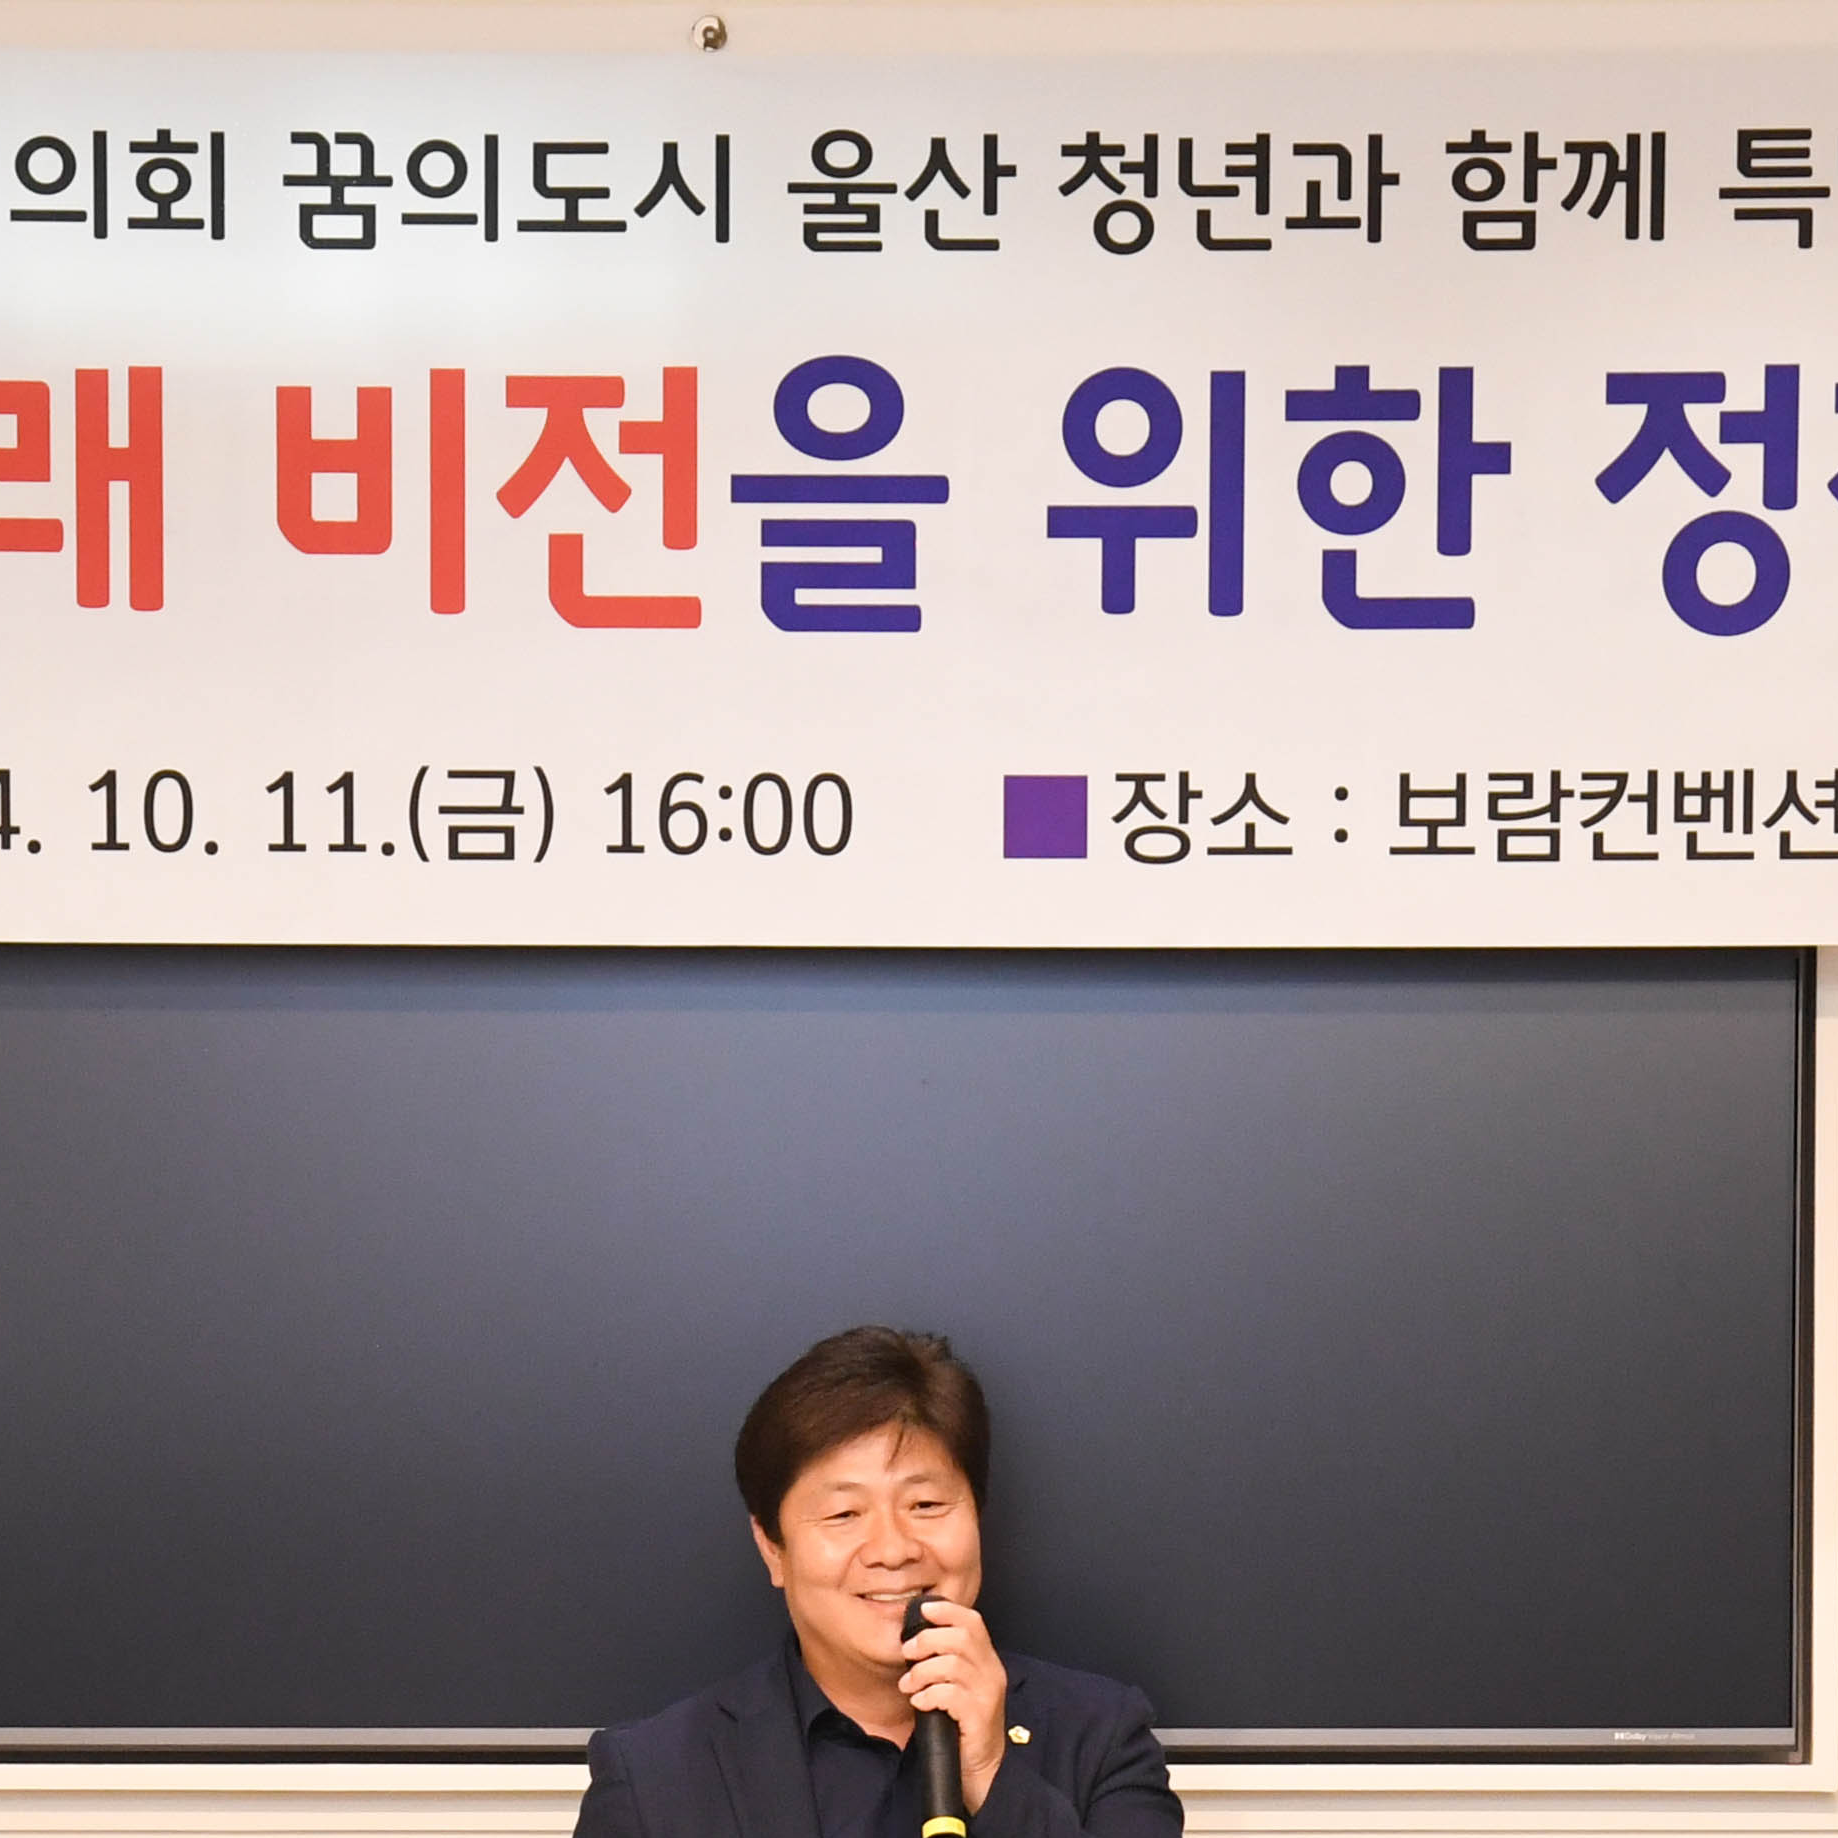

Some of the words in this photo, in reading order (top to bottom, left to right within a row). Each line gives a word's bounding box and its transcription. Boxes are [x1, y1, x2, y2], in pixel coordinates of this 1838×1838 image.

[282, 131, 730, 250] 꿈의도시
[787, 129, 1017, 253] 울산
[1058, 131, 1401, 256] 청년과
[1445, 129, 1667, 252] 함께
[276, 355, 950, 633] 비전을
[1046, 365, 1512, 630] 위한
[88, 769, 219, 856] 10.
[266, 765, 554, 863] 11.(금)
[604, 772, 853, 856] 16:00
[1112, 770, 1293, 865] 장소
